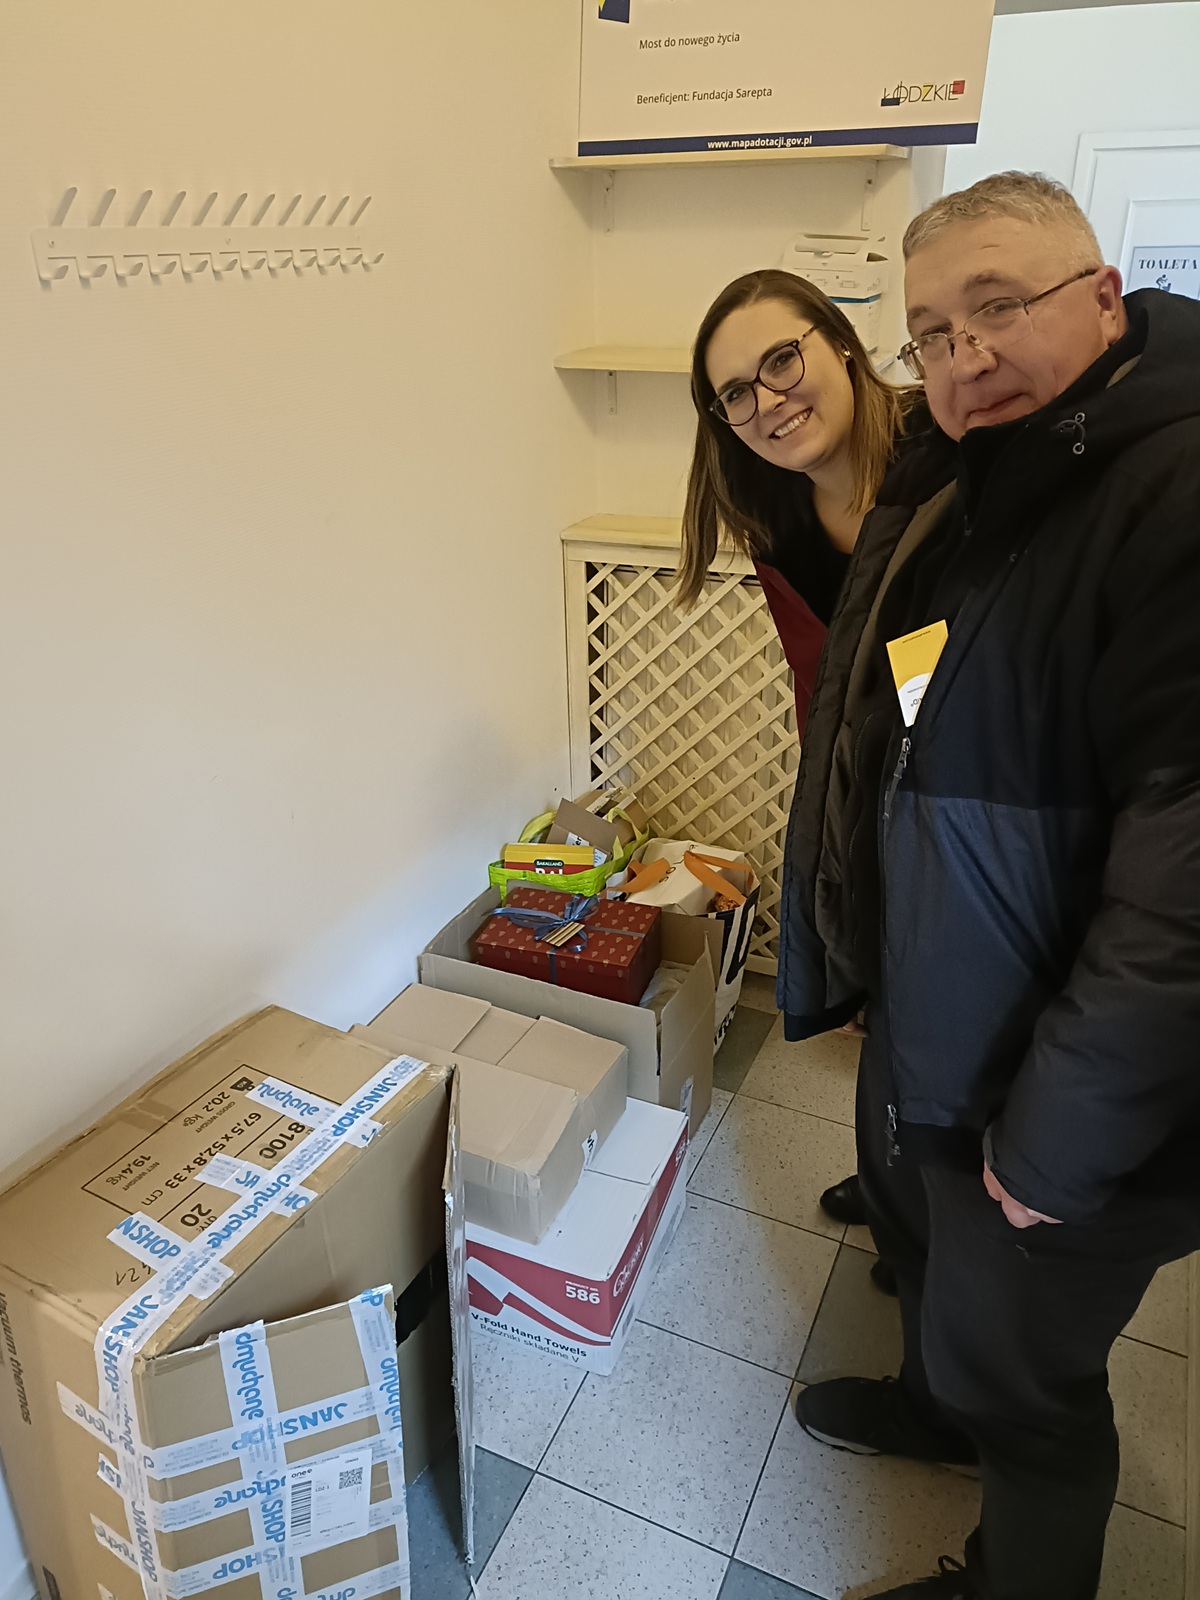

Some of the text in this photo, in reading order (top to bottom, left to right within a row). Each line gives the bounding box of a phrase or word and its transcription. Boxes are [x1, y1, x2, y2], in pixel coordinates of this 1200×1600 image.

[639, 32, 741, 50] Most do nowego życia
[636, 87, 773, 105] Beneficjent: Fundacja Sarepta
[707, 135, 813, 149] www.mapadotacji.gov.pl
[1138, 258, 1198, 270] TOALETA
[202, 1091, 231, 1113] 20,2
[330, 1076, 398, 1137] JANSHOP
[195, 1101, 236, 1133] GROSS WEIGHT
[230, 1112, 262, 1136] 67,5
[193, 1140, 226, 1167] 52,8
[122, 1168, 148, 1192] WEIGHT
[165, 1172, 188, 1189] 33
[141, 1189, 163, 1206] cm
[180, 1203, 212, 1228] 20
[565, 1285, 601, 1305] 586
[471, 1312, 587, 1357] V-Fold Hand Towels
[480, 1323, 521, 1342] Ręczniki
[571, 1355, 580, 1363] V
[232, 1331, 265, 1421] dmuchane
[10, 1356, 32, 1426] thermos
[130, 1500, 158, 1583] JANSHOP
